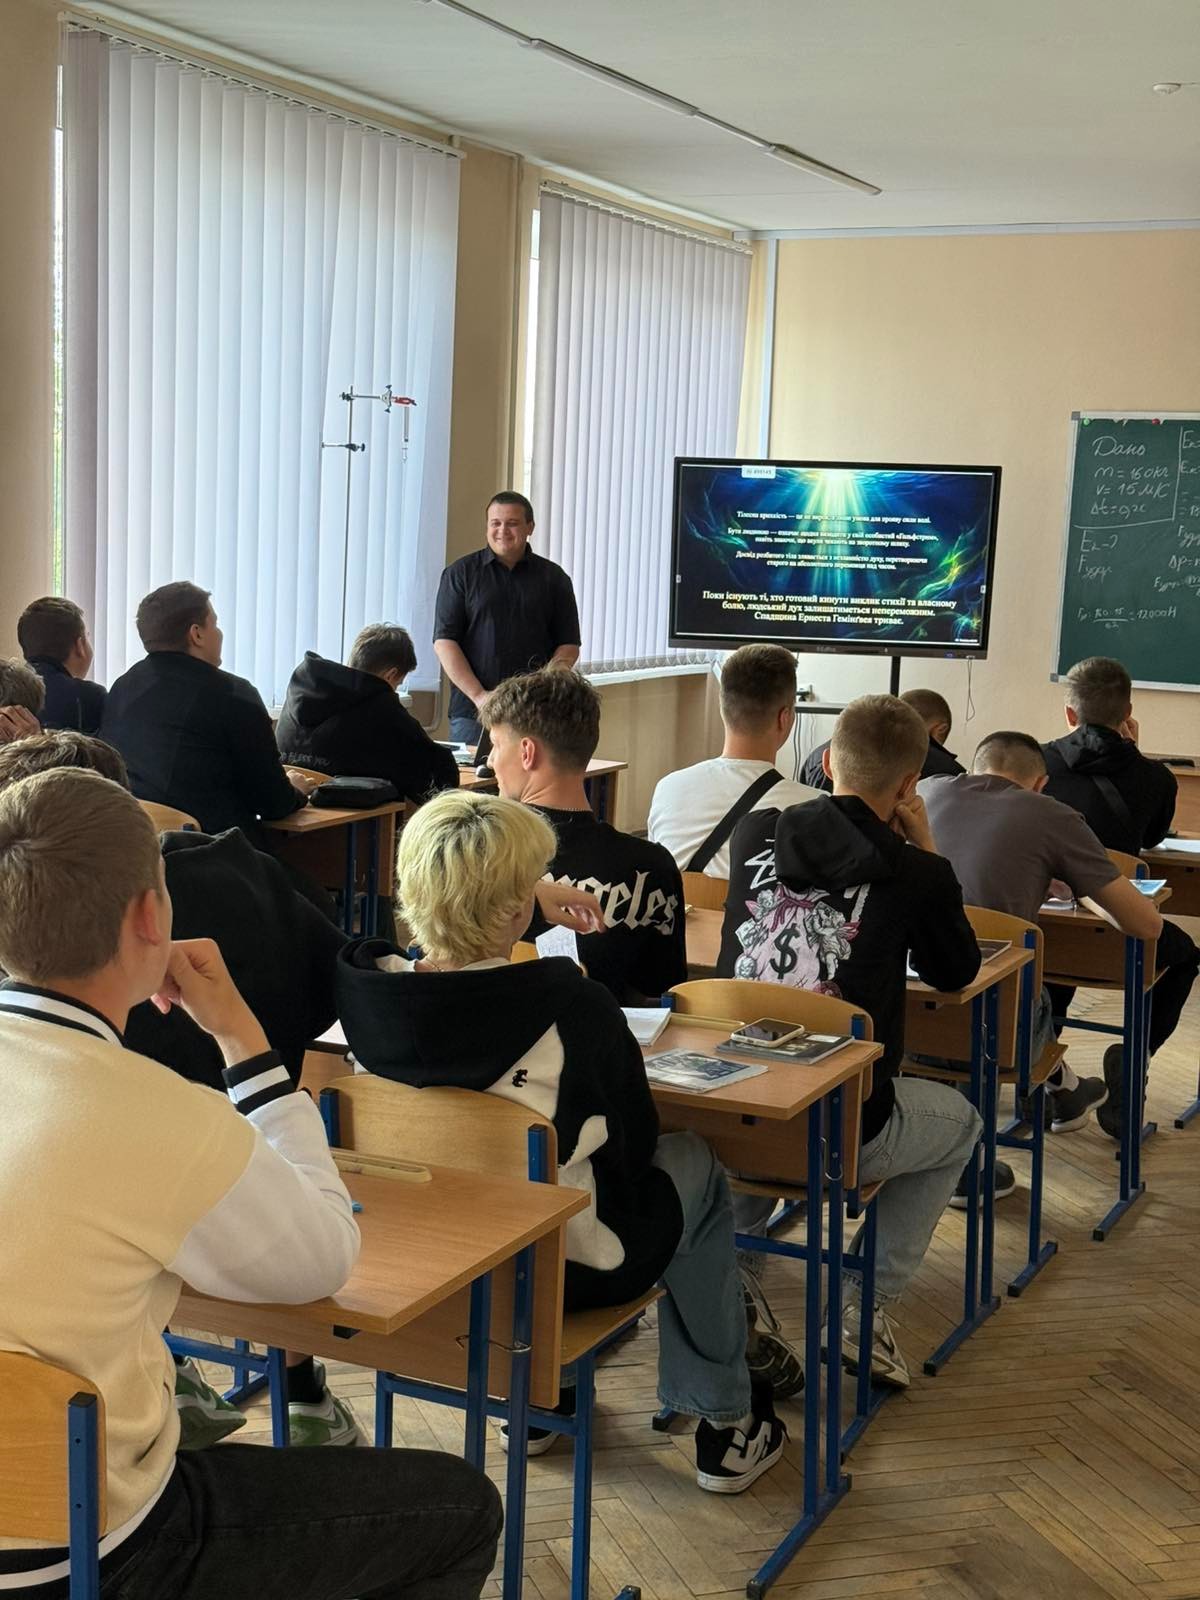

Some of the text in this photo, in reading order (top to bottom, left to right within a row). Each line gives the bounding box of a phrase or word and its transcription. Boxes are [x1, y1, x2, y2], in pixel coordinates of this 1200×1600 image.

[1092, 435, 1146, 456] Дано
[702, 590, 725, 599] Поки
[726, 591, 758, 602] існують
[759, 592, 769, 602] ті,
[770, 594, 784, 602] хто
[785, 594, 818, 603] готовий
[819, 596, 849, 605] кинути
[881, 597, 906, 606] стихії
[917, 600, 957, 609] власному
[722, 601, 745, 610] болю,
[747, 603, 787, 611] людський
[788, 604, 802, 613] дух
[804, 606, 870, 614] залишатиметься
[798, 613, 831, 623] Ернеста
